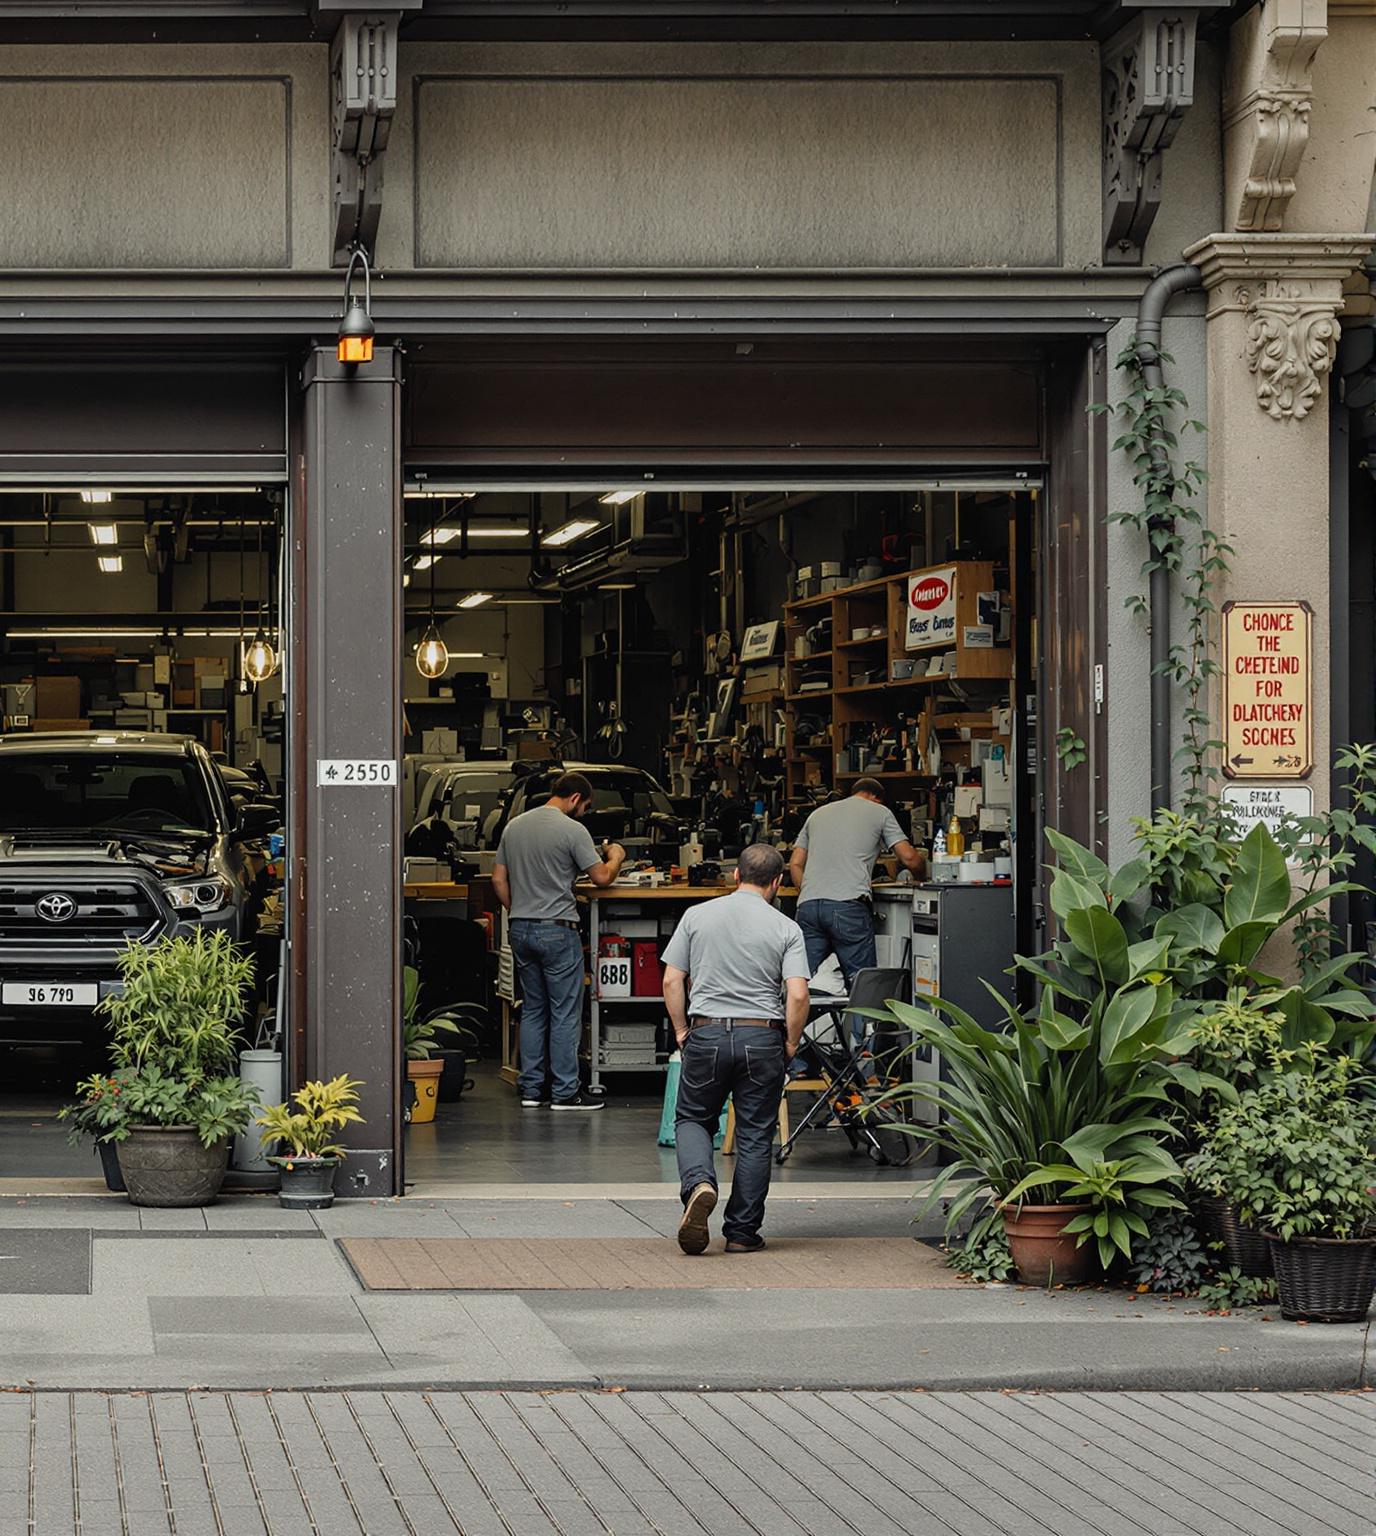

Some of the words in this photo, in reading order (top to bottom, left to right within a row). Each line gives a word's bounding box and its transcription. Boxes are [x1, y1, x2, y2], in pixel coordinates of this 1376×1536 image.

[1256, 635, 1281, 652] THE
[1255, 680, 1283, 697] FOR
[344, 763, 391, 781] 2550
[50, 987, 74, 1002] 790
